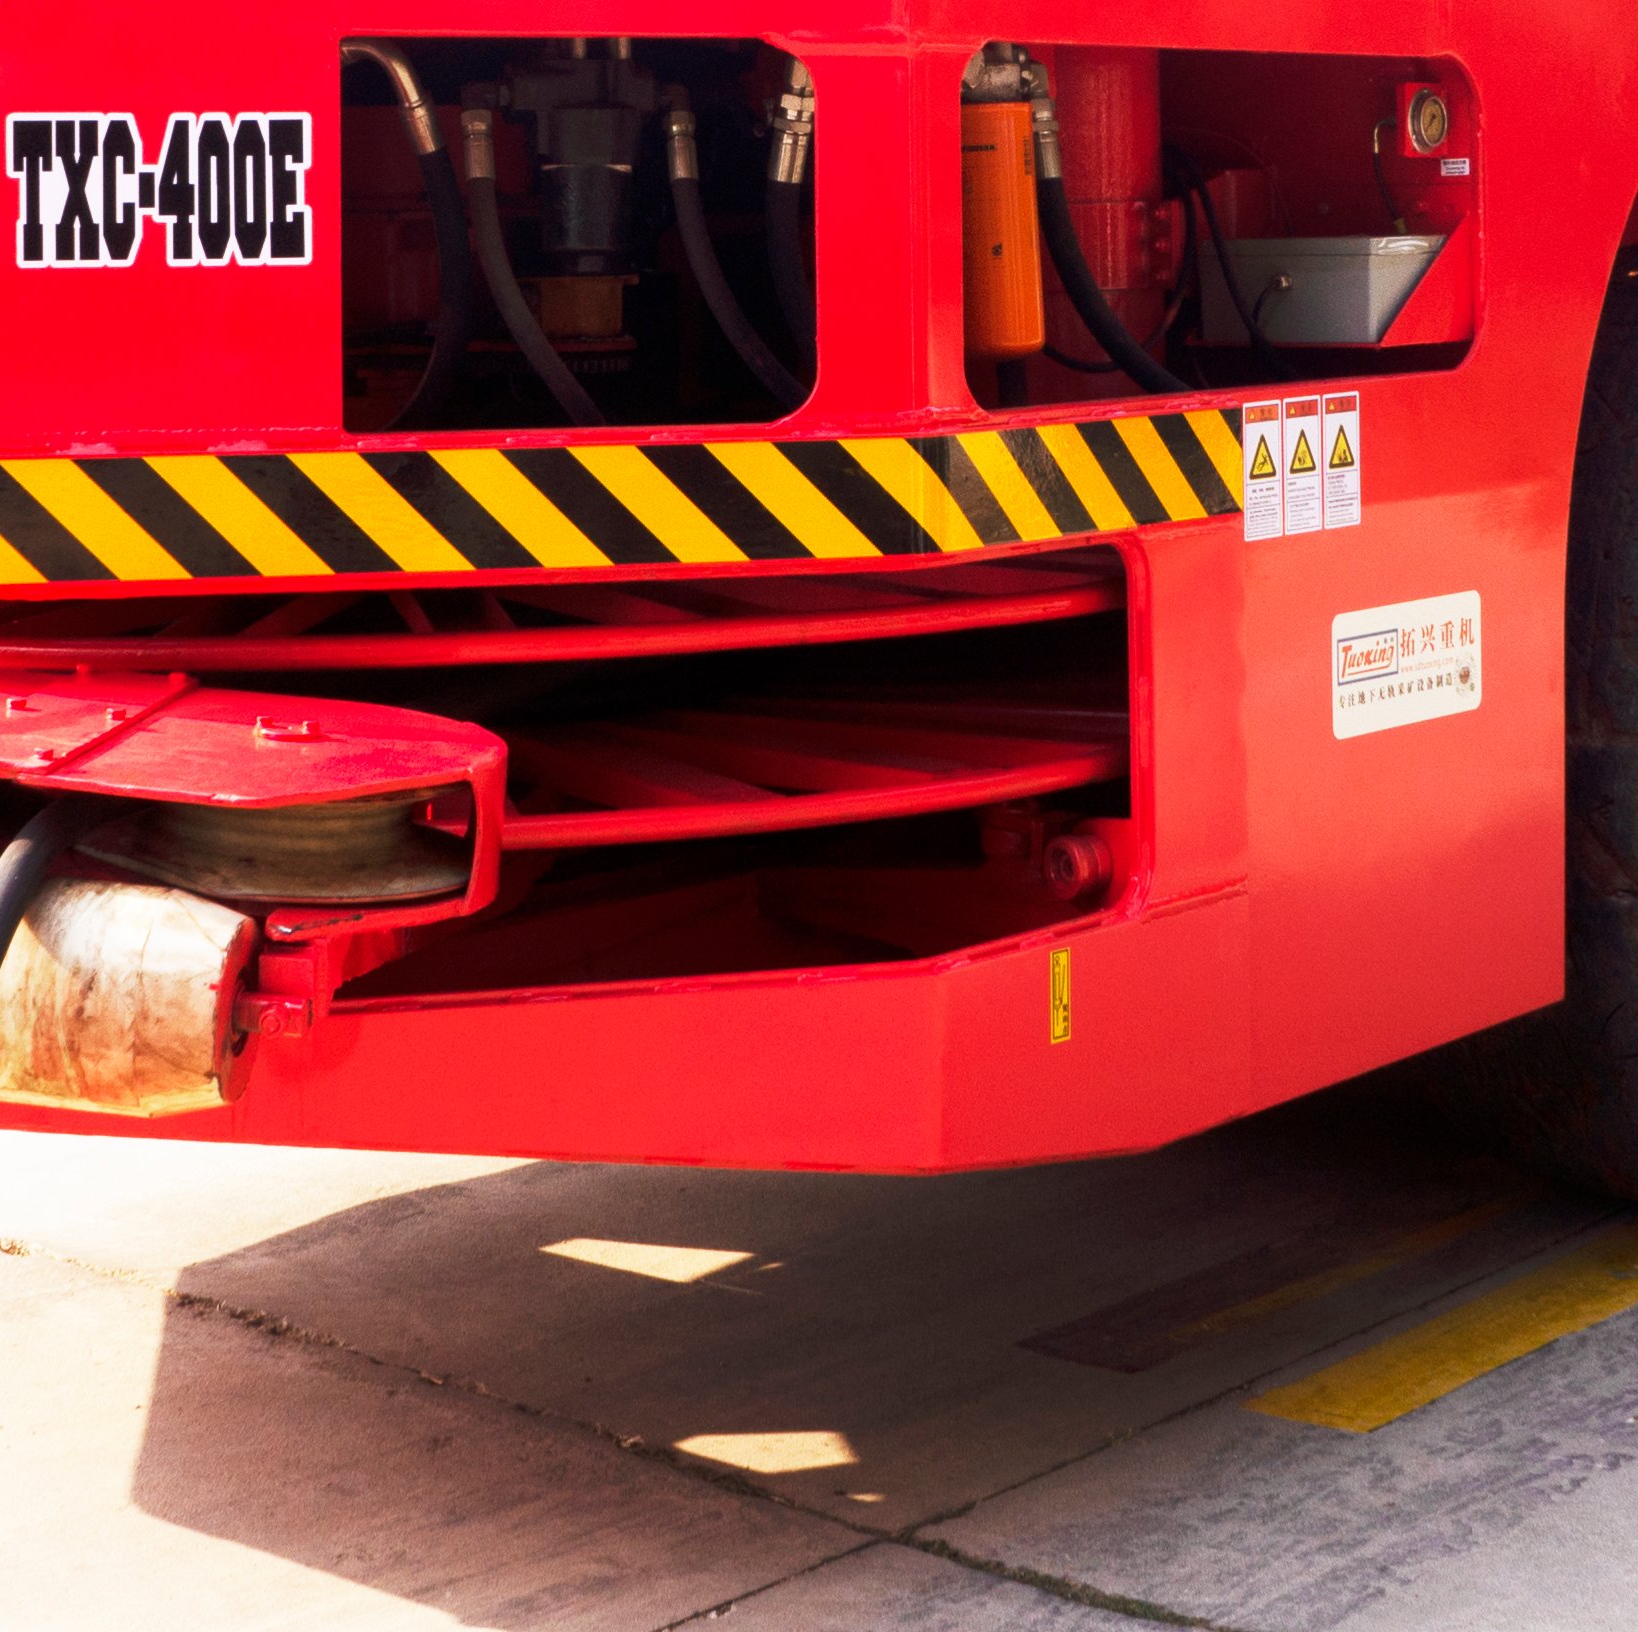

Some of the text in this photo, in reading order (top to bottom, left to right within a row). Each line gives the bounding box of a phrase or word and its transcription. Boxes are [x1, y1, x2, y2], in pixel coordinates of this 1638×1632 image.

[11, 118, 307, 263] TXC-400E
[1399, 617, 1475, 659] 拓兴重机
